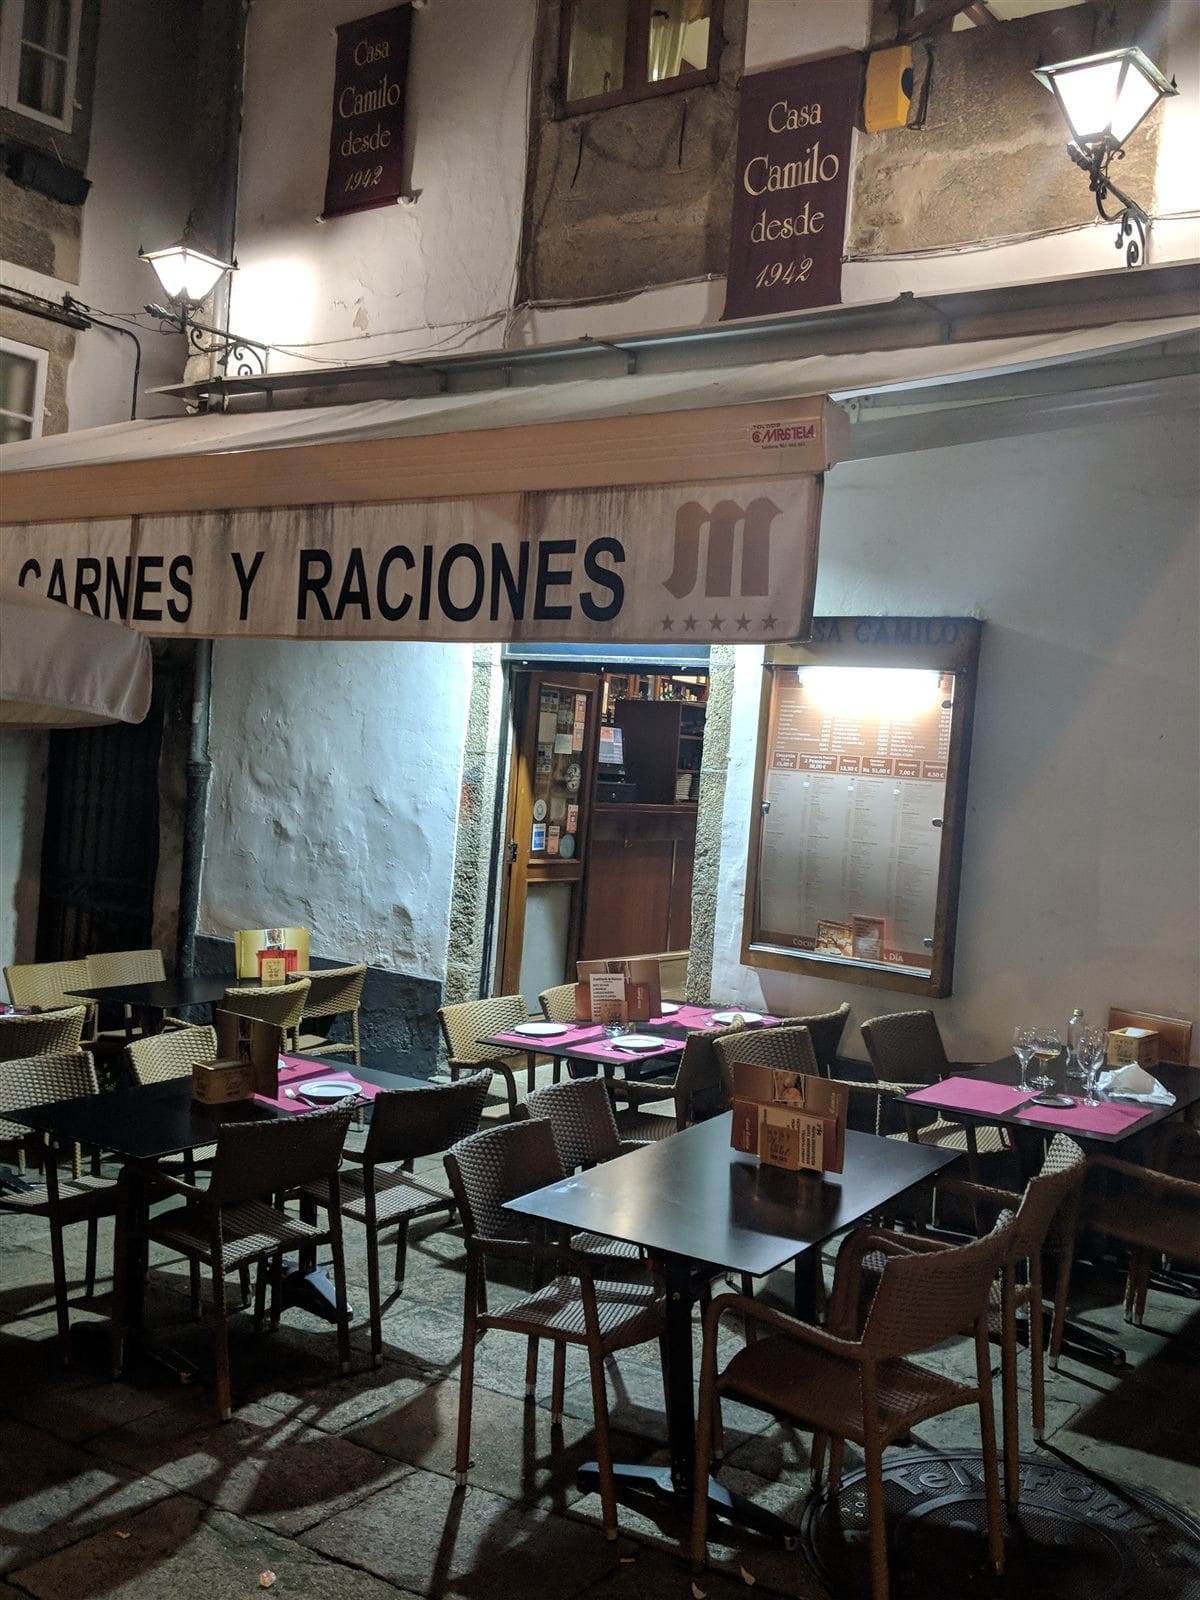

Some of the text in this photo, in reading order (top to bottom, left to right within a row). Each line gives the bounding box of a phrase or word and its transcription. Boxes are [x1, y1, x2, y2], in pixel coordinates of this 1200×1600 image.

[354, 40, 389, 66] Casa
[339, 73, 401, 119] Camilo
[768, 100, 822, 134] Casa
[341, 122, 391, 157] desde
[345, 165, 383, 192] 1942
[743, 141, 840, 196] Camilo
[751, 201, 825, 243] desde
[755, 256, 813, 289] 1942
[230, 551, 265, 621] Y
[297, 537, 626, 623] RACIONES
[855, 619, 959, 644] CAMILO
